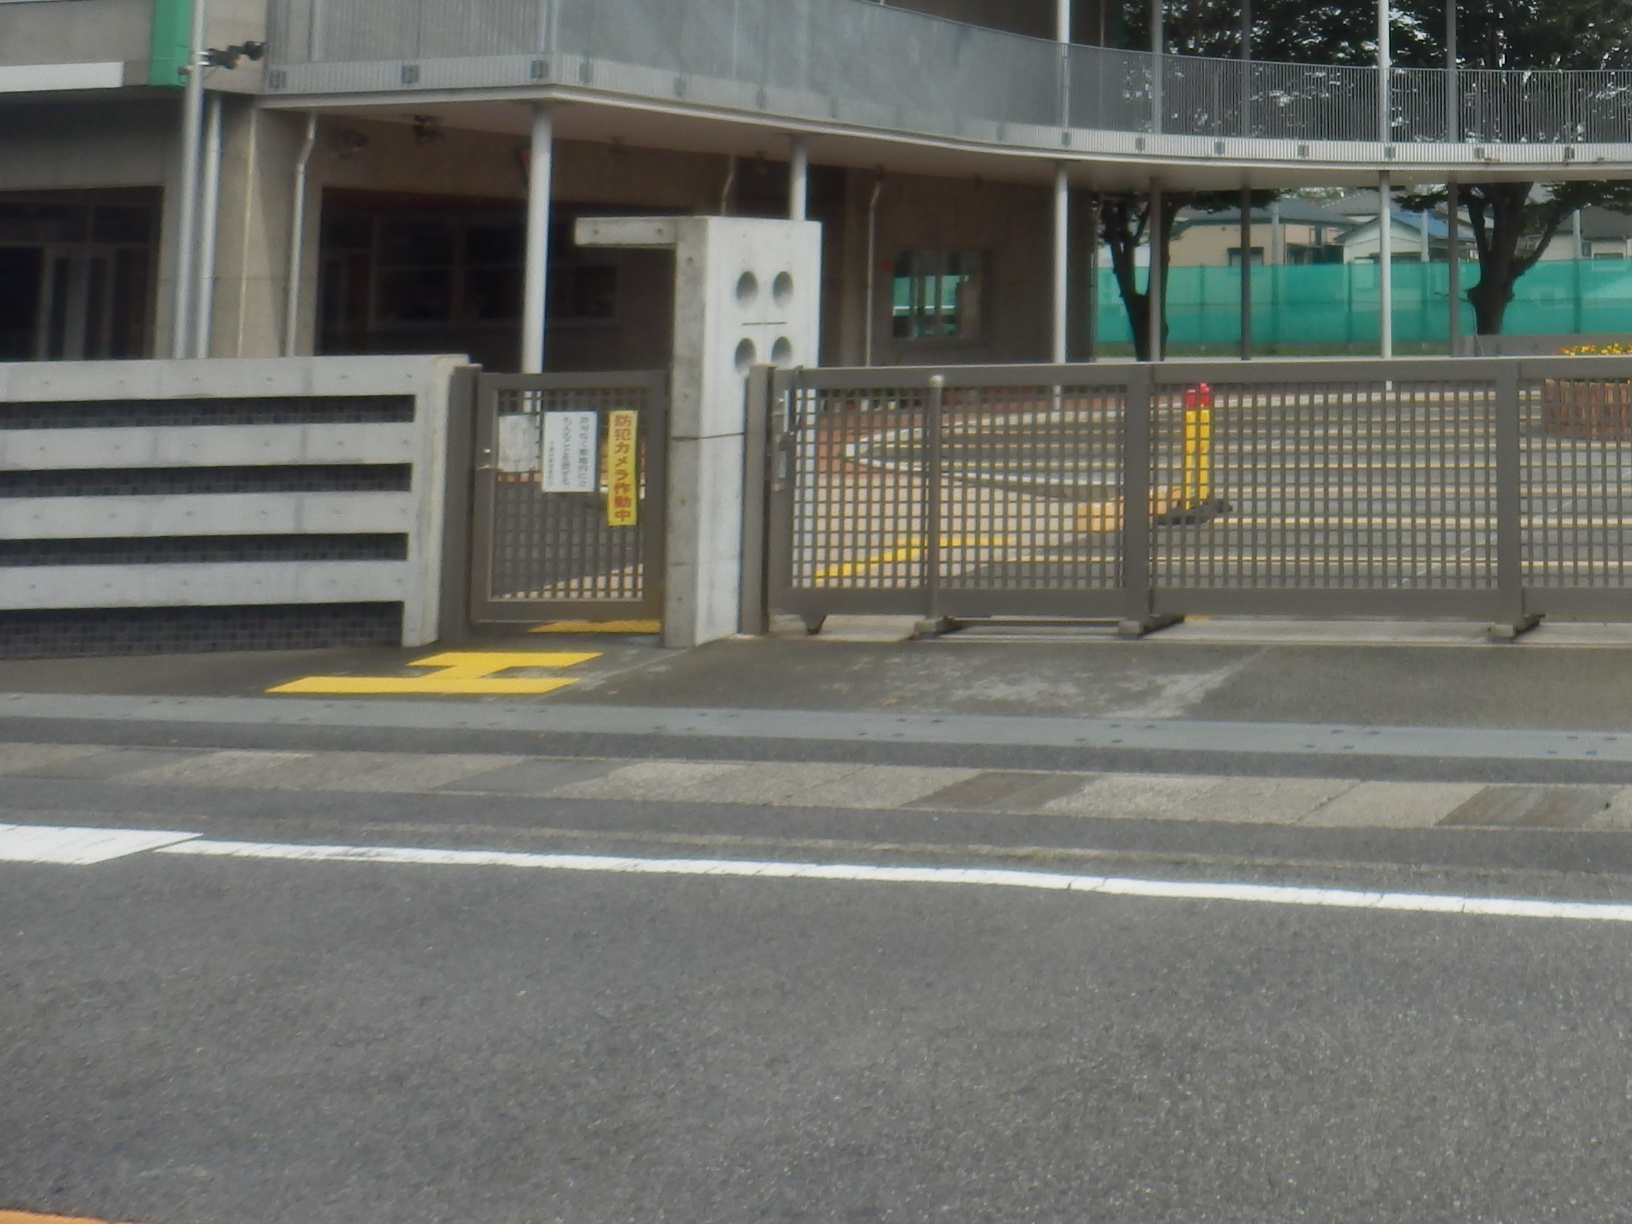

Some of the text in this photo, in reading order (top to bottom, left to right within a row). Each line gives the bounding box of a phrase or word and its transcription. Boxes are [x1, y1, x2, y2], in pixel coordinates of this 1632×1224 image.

[613, 414, 632, 522] 防犯カメラ作動中
